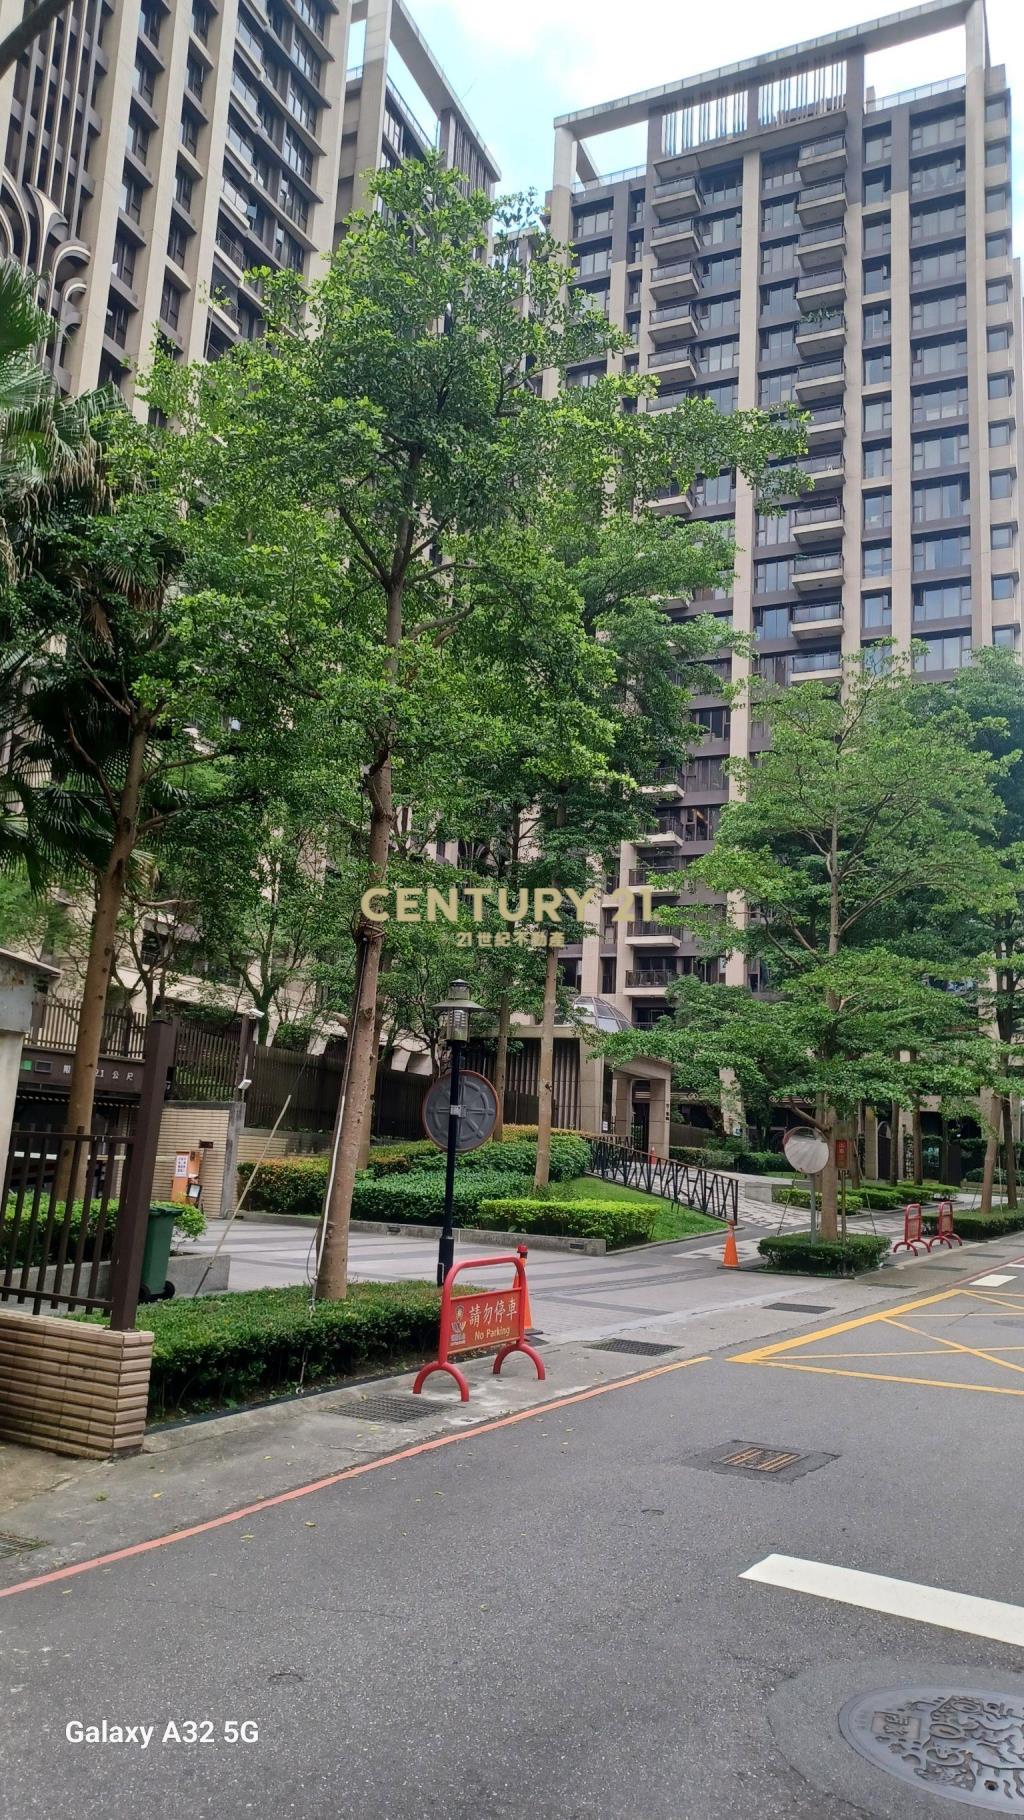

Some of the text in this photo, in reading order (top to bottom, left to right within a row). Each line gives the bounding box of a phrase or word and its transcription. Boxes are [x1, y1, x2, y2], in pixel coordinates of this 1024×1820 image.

[468, 1296, 517, 1328] 請勿停車
[474, 1327, 511, 1340] No Parking
